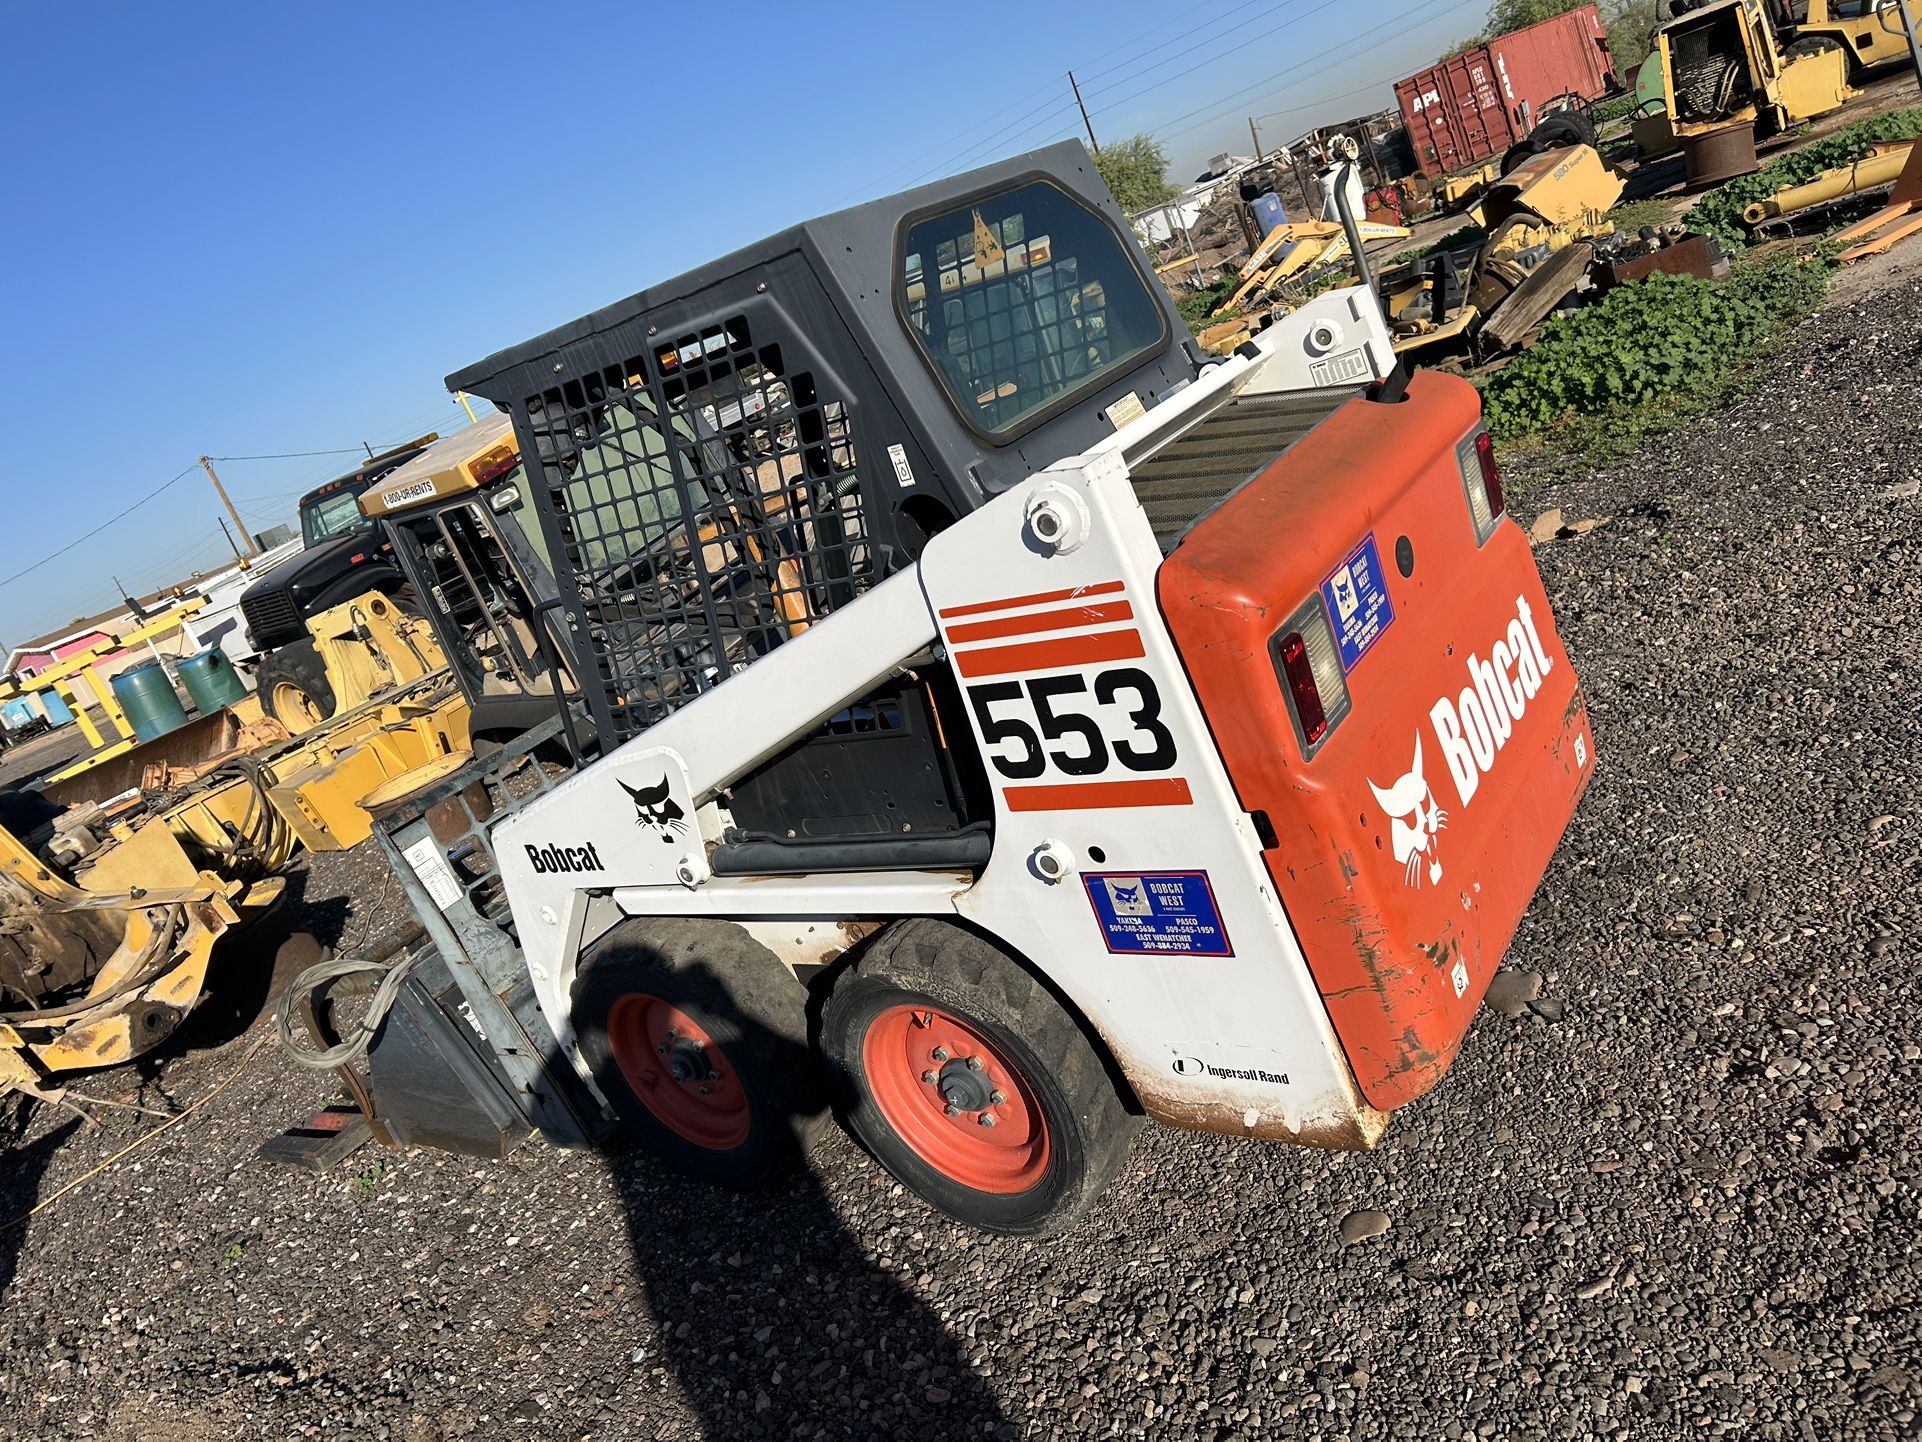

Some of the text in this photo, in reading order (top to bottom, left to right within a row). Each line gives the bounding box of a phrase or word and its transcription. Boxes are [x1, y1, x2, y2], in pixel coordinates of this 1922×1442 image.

[1553, 164, 1570, 181] 580
[1248, 249, 1268, 270] CASE
[384, 481, 433, 505] 1-800-UR-RENTS
[1429, 593, 1551, 808] Bobcat
[965, 667, 1178, 779] 553
[523, 841, 606, 874] Bobcat
[1150, 883, 1184, 894] BOBCAT
[1158, 895, 1184, 906] WEST
[1135, 933, 1152, 941] EAST
[1206, 1064, 1290, 1085] Ingersoll Rand
